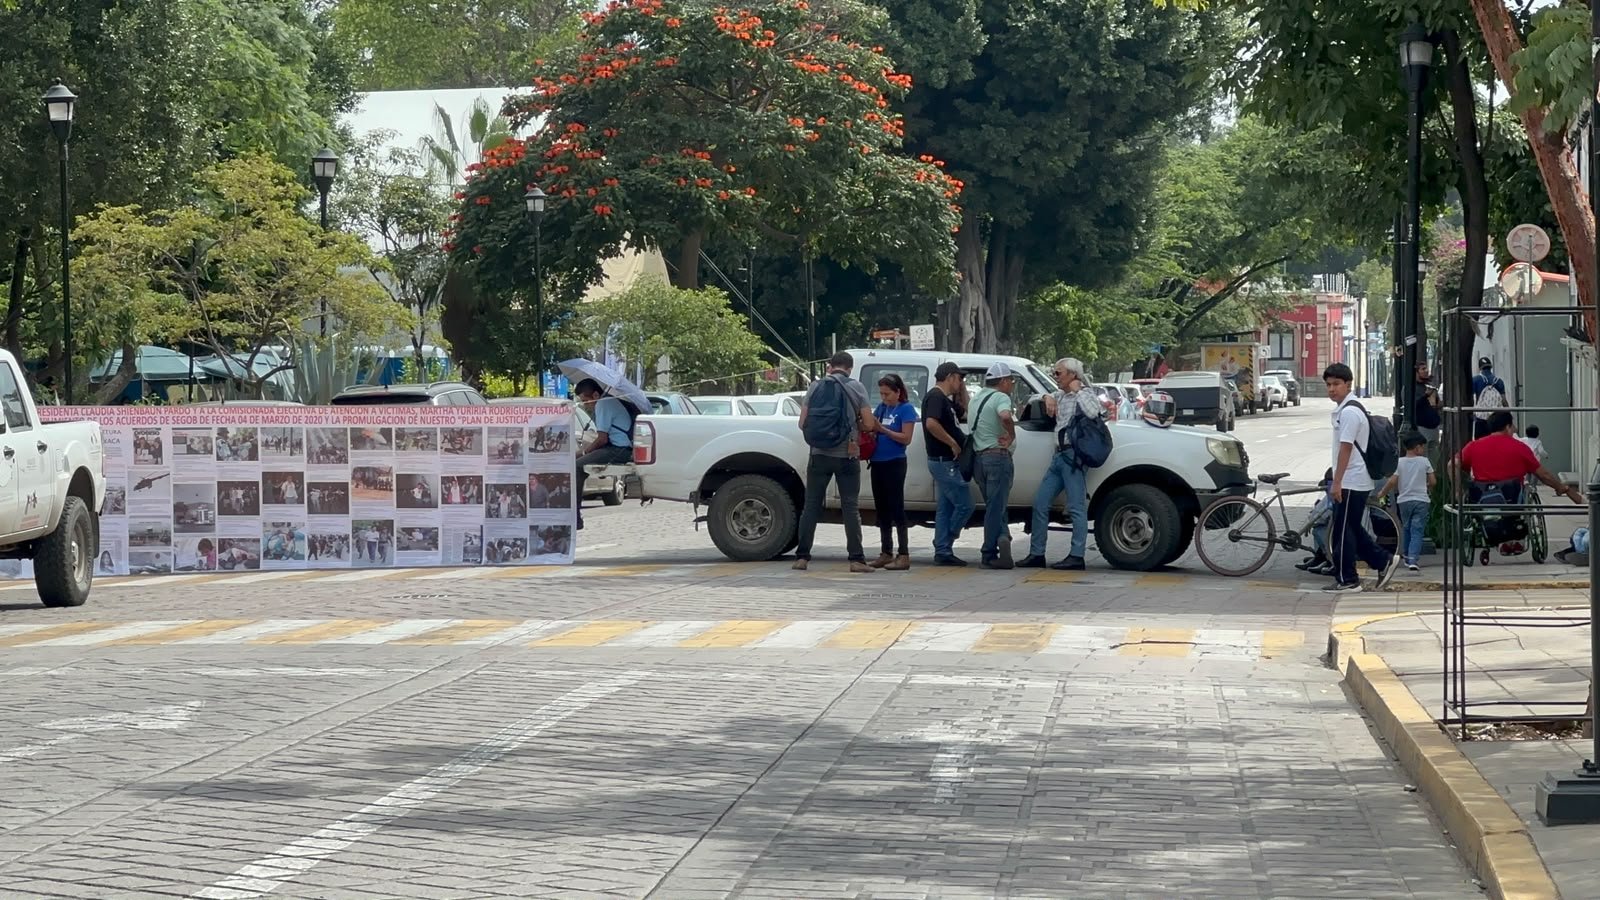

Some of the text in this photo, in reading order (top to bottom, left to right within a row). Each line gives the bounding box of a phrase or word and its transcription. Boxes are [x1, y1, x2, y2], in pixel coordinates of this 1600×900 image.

[37, 407, 79, 416] RESIDENTA
[81, 407, 115, 416] CLAUDIA
[164, 407, 191, 415] PARDO
[193, 407, 198, 415] Y
[199, 407, 205, 415] A
[207, 407, 216, 415] LA
[218, 407, 275, 415] COMISIONADA
[277, 407, 316, 415] EJECUTIVA
[318, 407, 330, 415] DE
[330, 407, 369, 415] ATENCION
[371, 407, 377, 415] A
[420, 407, 454, 415] MARTHA
[456, 407, 487, 415] YURIRIA
[489, 406, 533, 415] RODRIGUEZ
[99, 416, 114, 425] LOS
[116, 416, 158, 425] ACUERDOS
[159, 416, 170, 425] DE
[172, 416, 197, 425] SEGOB
[199, 416, 209, 425] DE
[211, 416, 236, 424] FECHA
[238, 416, 247, 424] 04
[249, 416, 260, 424] DE
[262, 416, 290, 424] MARZO
[292, 416, 302, 424] DE
[304, 416, 323, 424] 2020
[324, 416, 330, 424] Y
[331, 416, 341, 424] LA
[342, 416, 406, 424] PROMULGACION
[408, 416, 418, 424] DE
[420, 416, 456, 424] NUESTRO
[484, 416, 494, 424] DE
